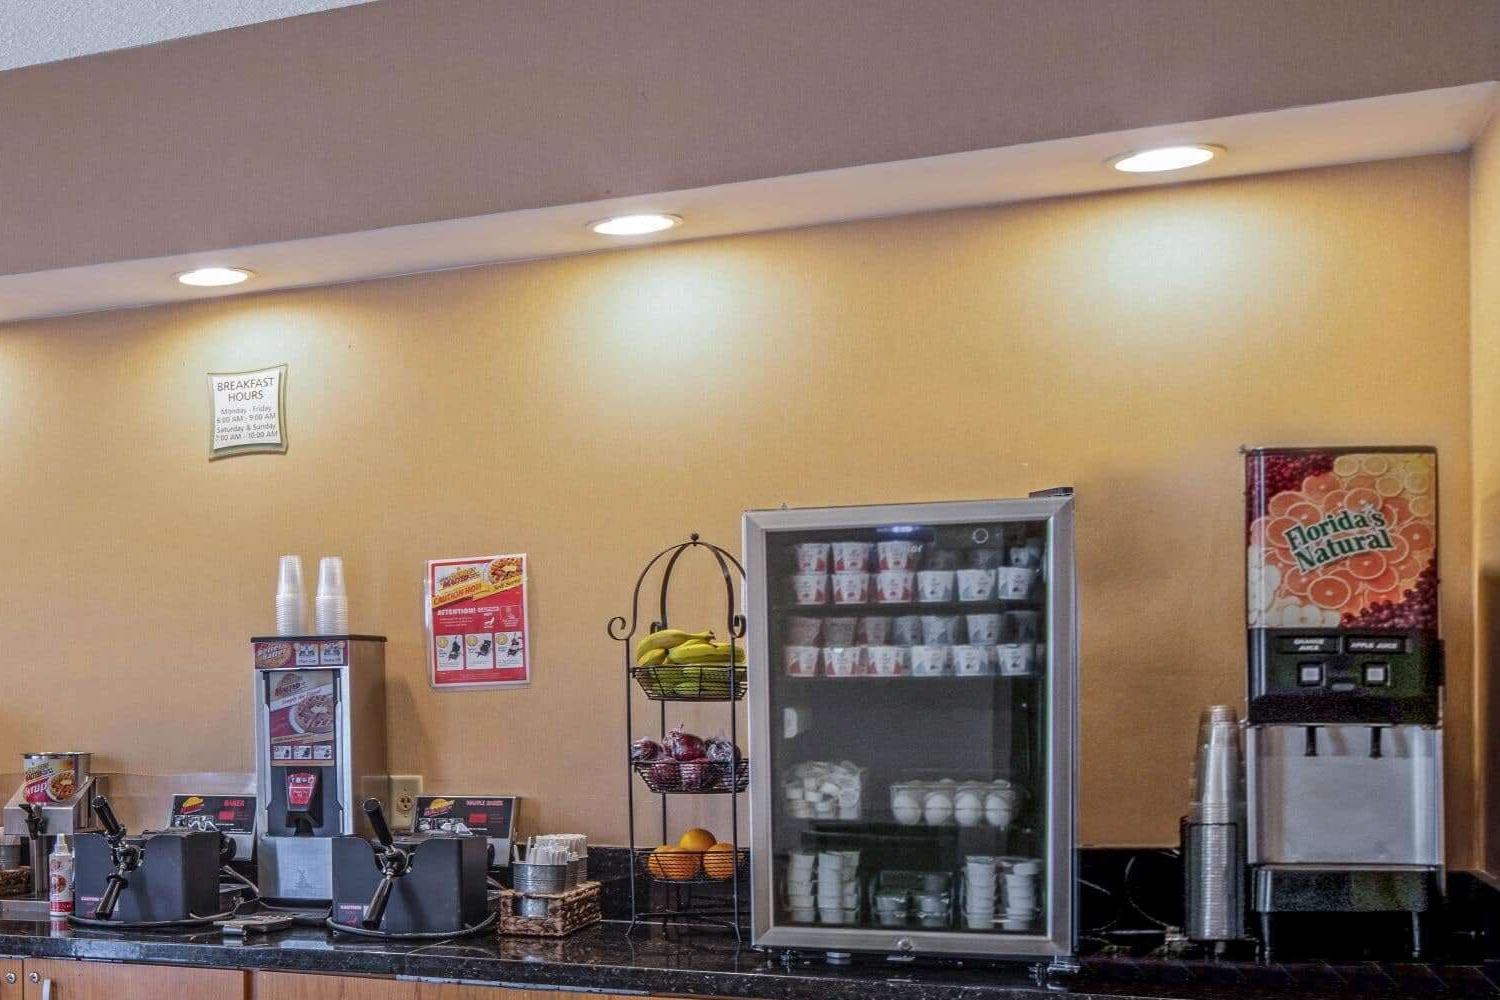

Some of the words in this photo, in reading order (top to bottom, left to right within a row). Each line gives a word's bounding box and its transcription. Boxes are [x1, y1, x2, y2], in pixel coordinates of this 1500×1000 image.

[217, 377, 274, 392] BREAKFAST
[228, 389, 264, 402] HOURS
[221, 407, 247, 416] Monday
[252, 404, 272, 413] Friday
[231, 415, 244, 423] AM
[249, 413, 263, 421] 9:00
[264, 412, 276, 420] AM
[216, 426, 244, 434] Saturday
[252, 423, 276, 432] Sunday
[1284, 510, 1386, 551] Florida's
[1294, 529, 1393, 572] Natural
